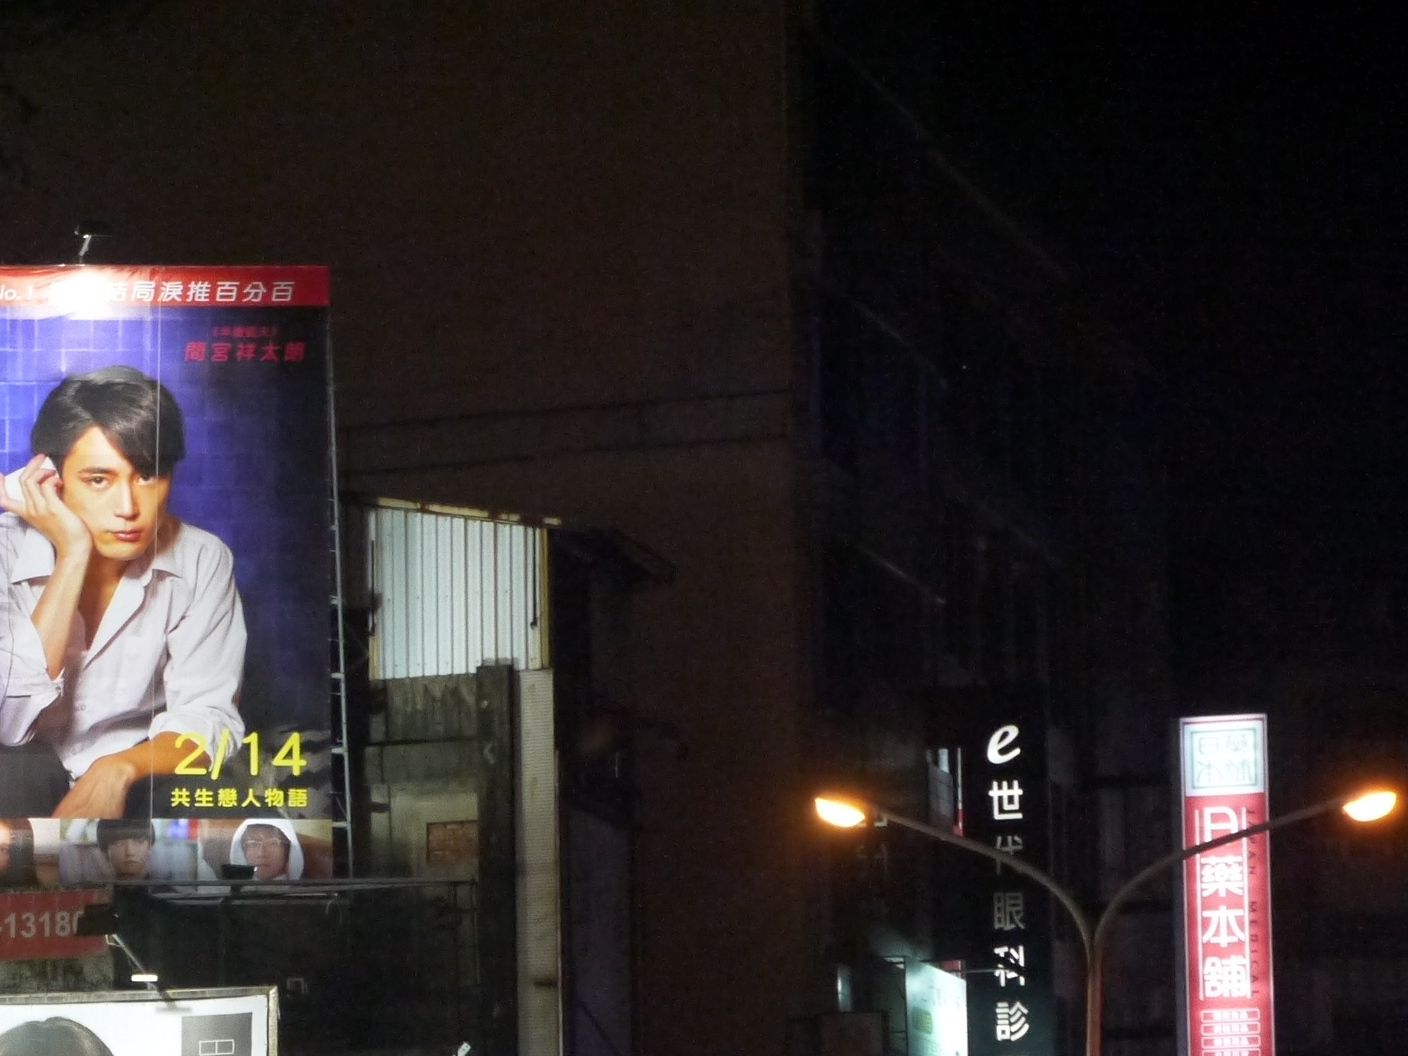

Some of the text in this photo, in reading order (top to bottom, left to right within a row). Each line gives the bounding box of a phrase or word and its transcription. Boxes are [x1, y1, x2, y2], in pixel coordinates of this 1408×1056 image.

[174, 730, 307, 780] 2/14
[170, 787, 308, 809] 共生戀人物語
